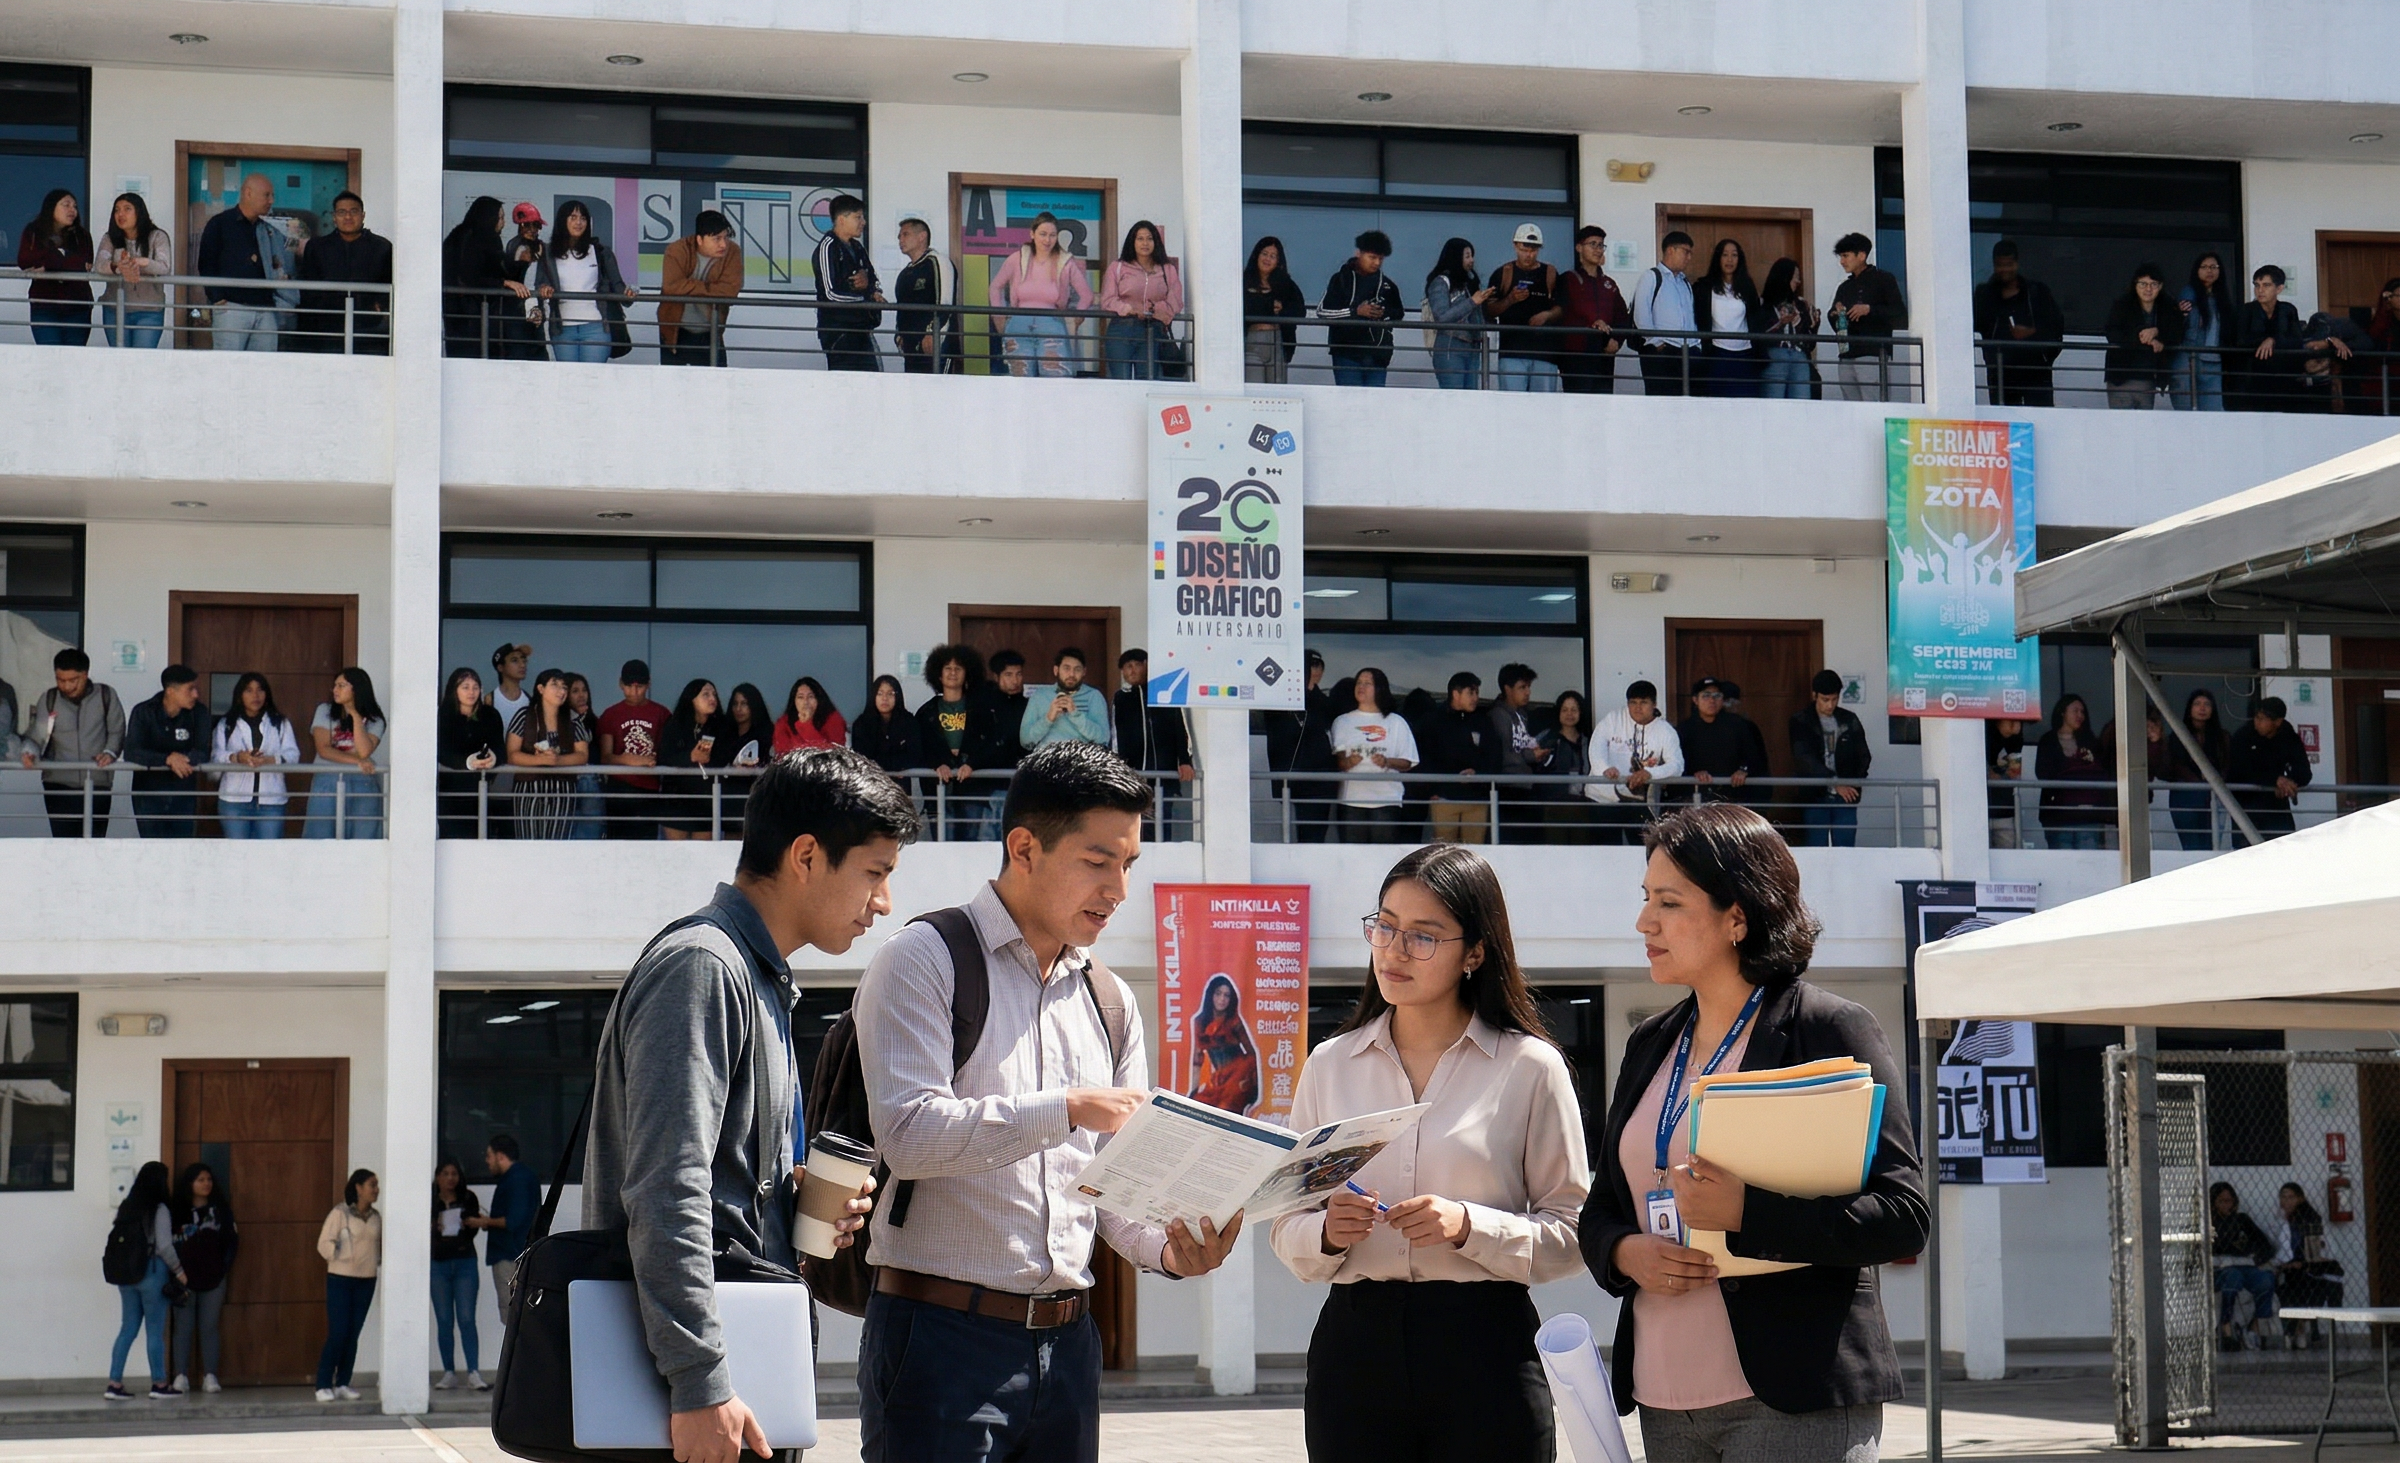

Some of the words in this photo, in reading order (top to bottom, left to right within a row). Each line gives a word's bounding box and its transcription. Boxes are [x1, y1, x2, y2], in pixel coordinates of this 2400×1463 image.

[1912, 453, 2008, 469] CONCIERTO
[1924, 485, 2001, 509] ZOTA
[1177, 537, 1280, 581] DISEÑO
[1177, 579, 1282, 618] GRÁFICO
[1177, 621, 1282, 638] ANIVERSARIO
[1166, 993, 1183, 1042] INTI
[1986, 1073, 2037, 1141] TÚ
